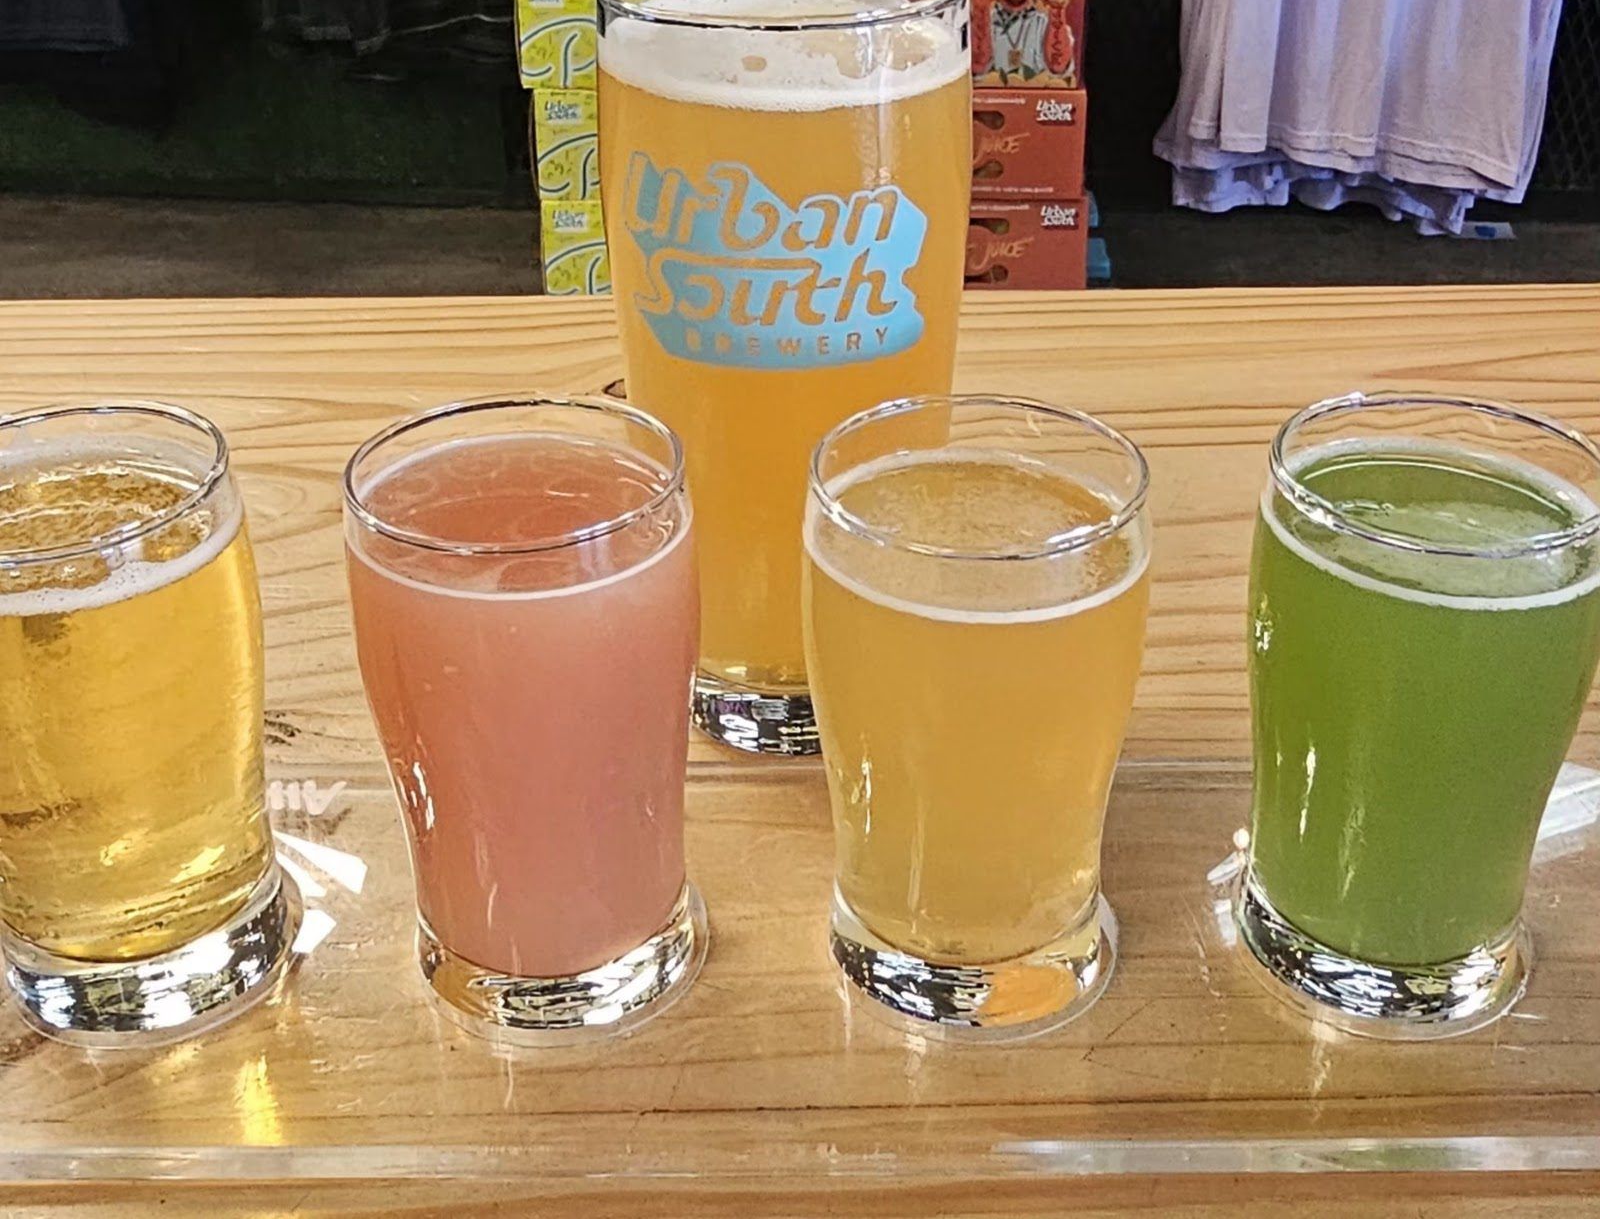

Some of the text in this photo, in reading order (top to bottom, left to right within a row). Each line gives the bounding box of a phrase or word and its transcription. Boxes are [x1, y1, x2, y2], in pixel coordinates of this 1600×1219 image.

[622, 151, 900, 253] Urban
[634, 247, 899, 327] South
[684, 326, 890, 358] BREWERY
